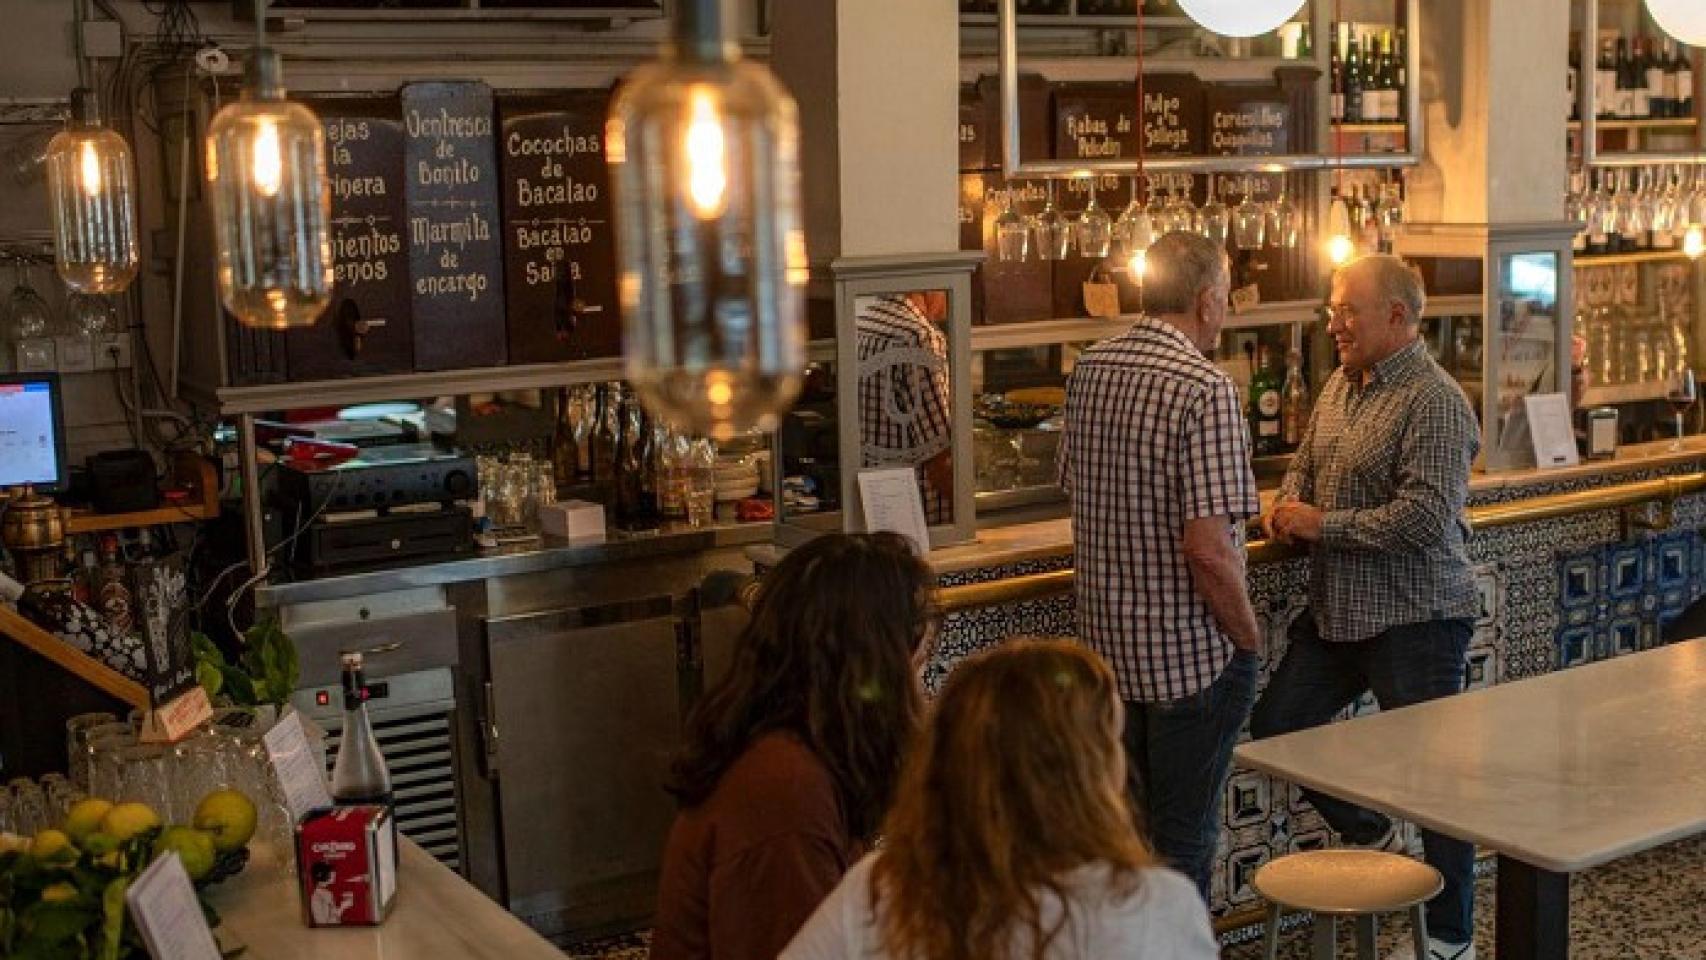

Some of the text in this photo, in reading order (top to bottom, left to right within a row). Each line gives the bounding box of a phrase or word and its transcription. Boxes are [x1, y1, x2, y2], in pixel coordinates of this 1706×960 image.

[327, 117, 370, 147] ejas
[406, 107, 491, 138] Ventresca
[435, 139, 455, 159] de
[507, 125, 600, 158] Cocochas
[332, 146, 352, 165] la
[541, 156, 564, 179] de
[330, 172, 387, 199] inera
[418, 158, 479, 191] Bonito
[516, 176, 598, 207] Bacalao
[331, 226, 401, 259] ientos
[516, 223, 592, 250] Bacalao
[440, 248, 459, 268] de
[335, 260, 388, 286] enos
[526, 260, 582, 285] Sala
[416, 272, 488, 302] encargo
